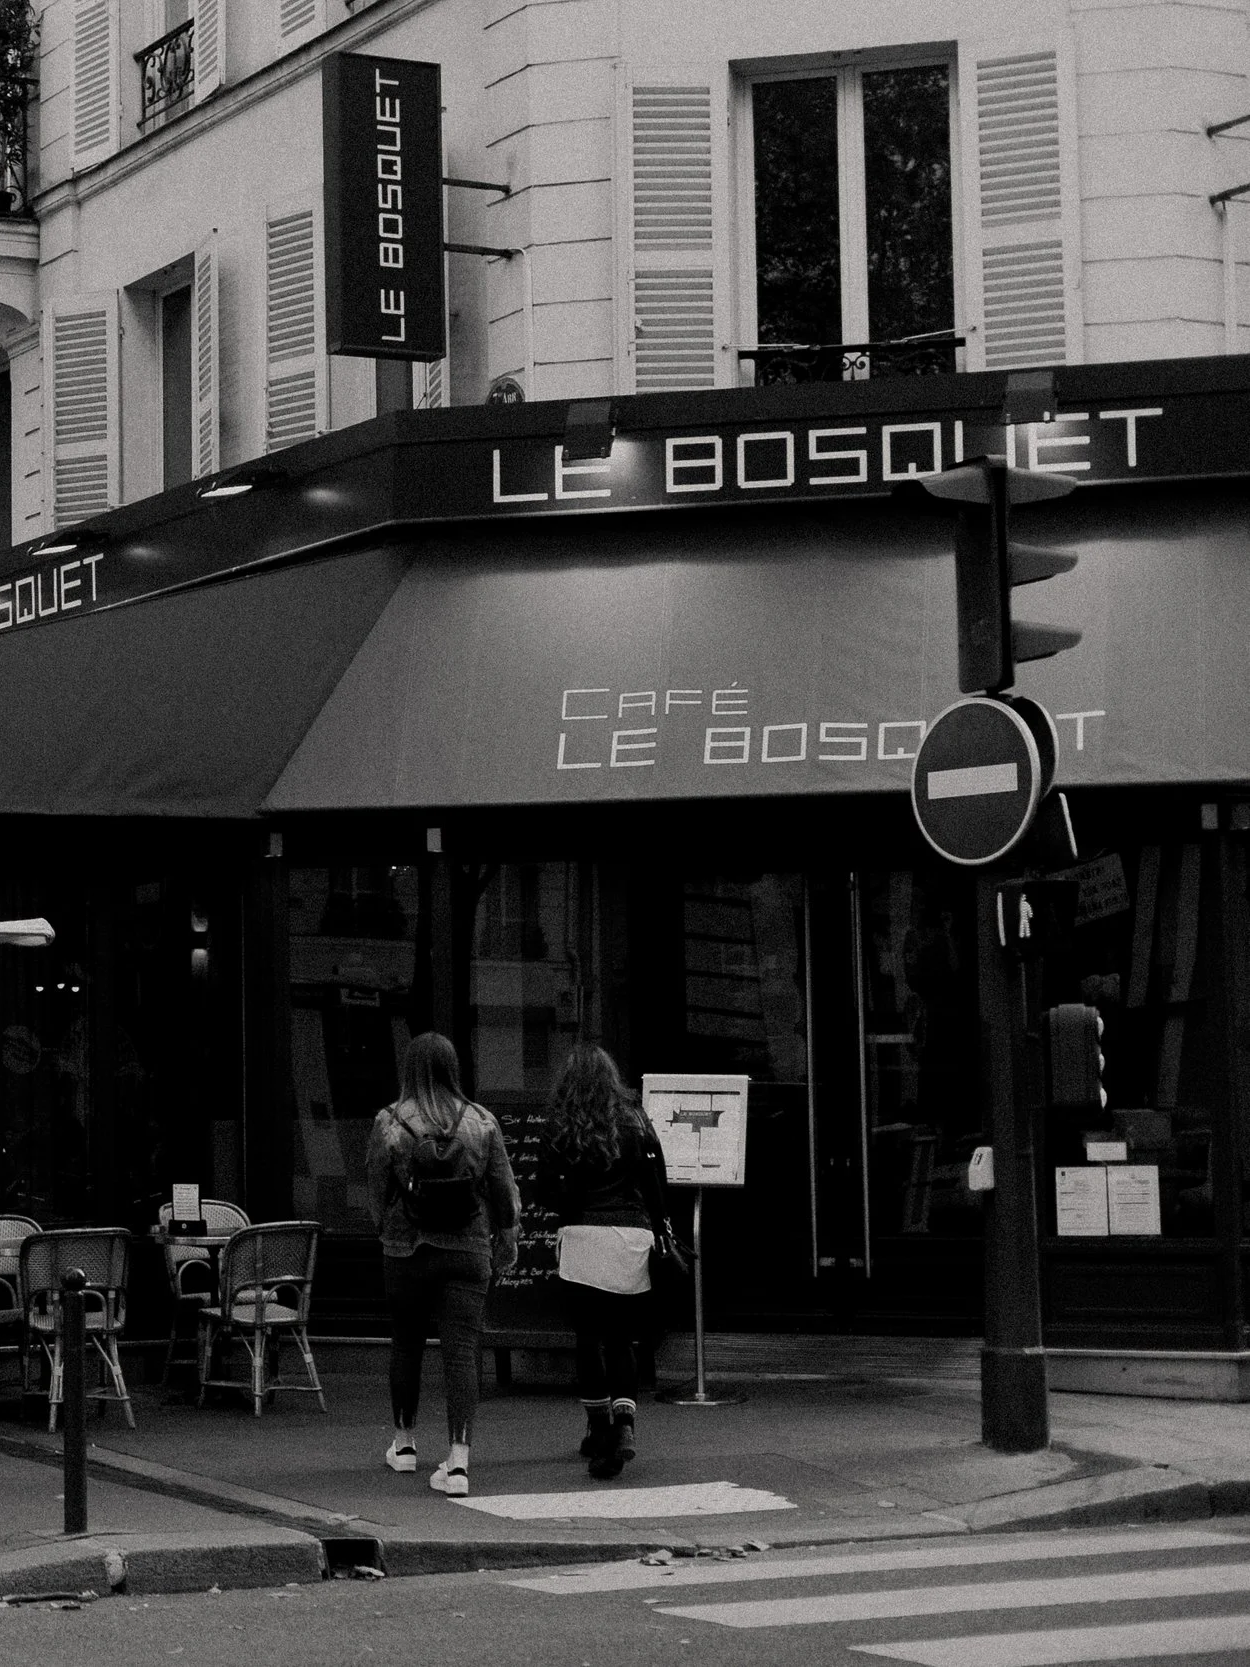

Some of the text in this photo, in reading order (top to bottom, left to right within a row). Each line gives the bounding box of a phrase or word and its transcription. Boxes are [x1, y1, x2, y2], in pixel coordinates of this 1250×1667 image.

[375, 67, 406, 342] LE BOSQUET
[493, 407, 1164, 503] LE BOSQUET
[557, 710, 1106, 770] LE BOSQT
[561, 681, 749, 721] CAFÉ
